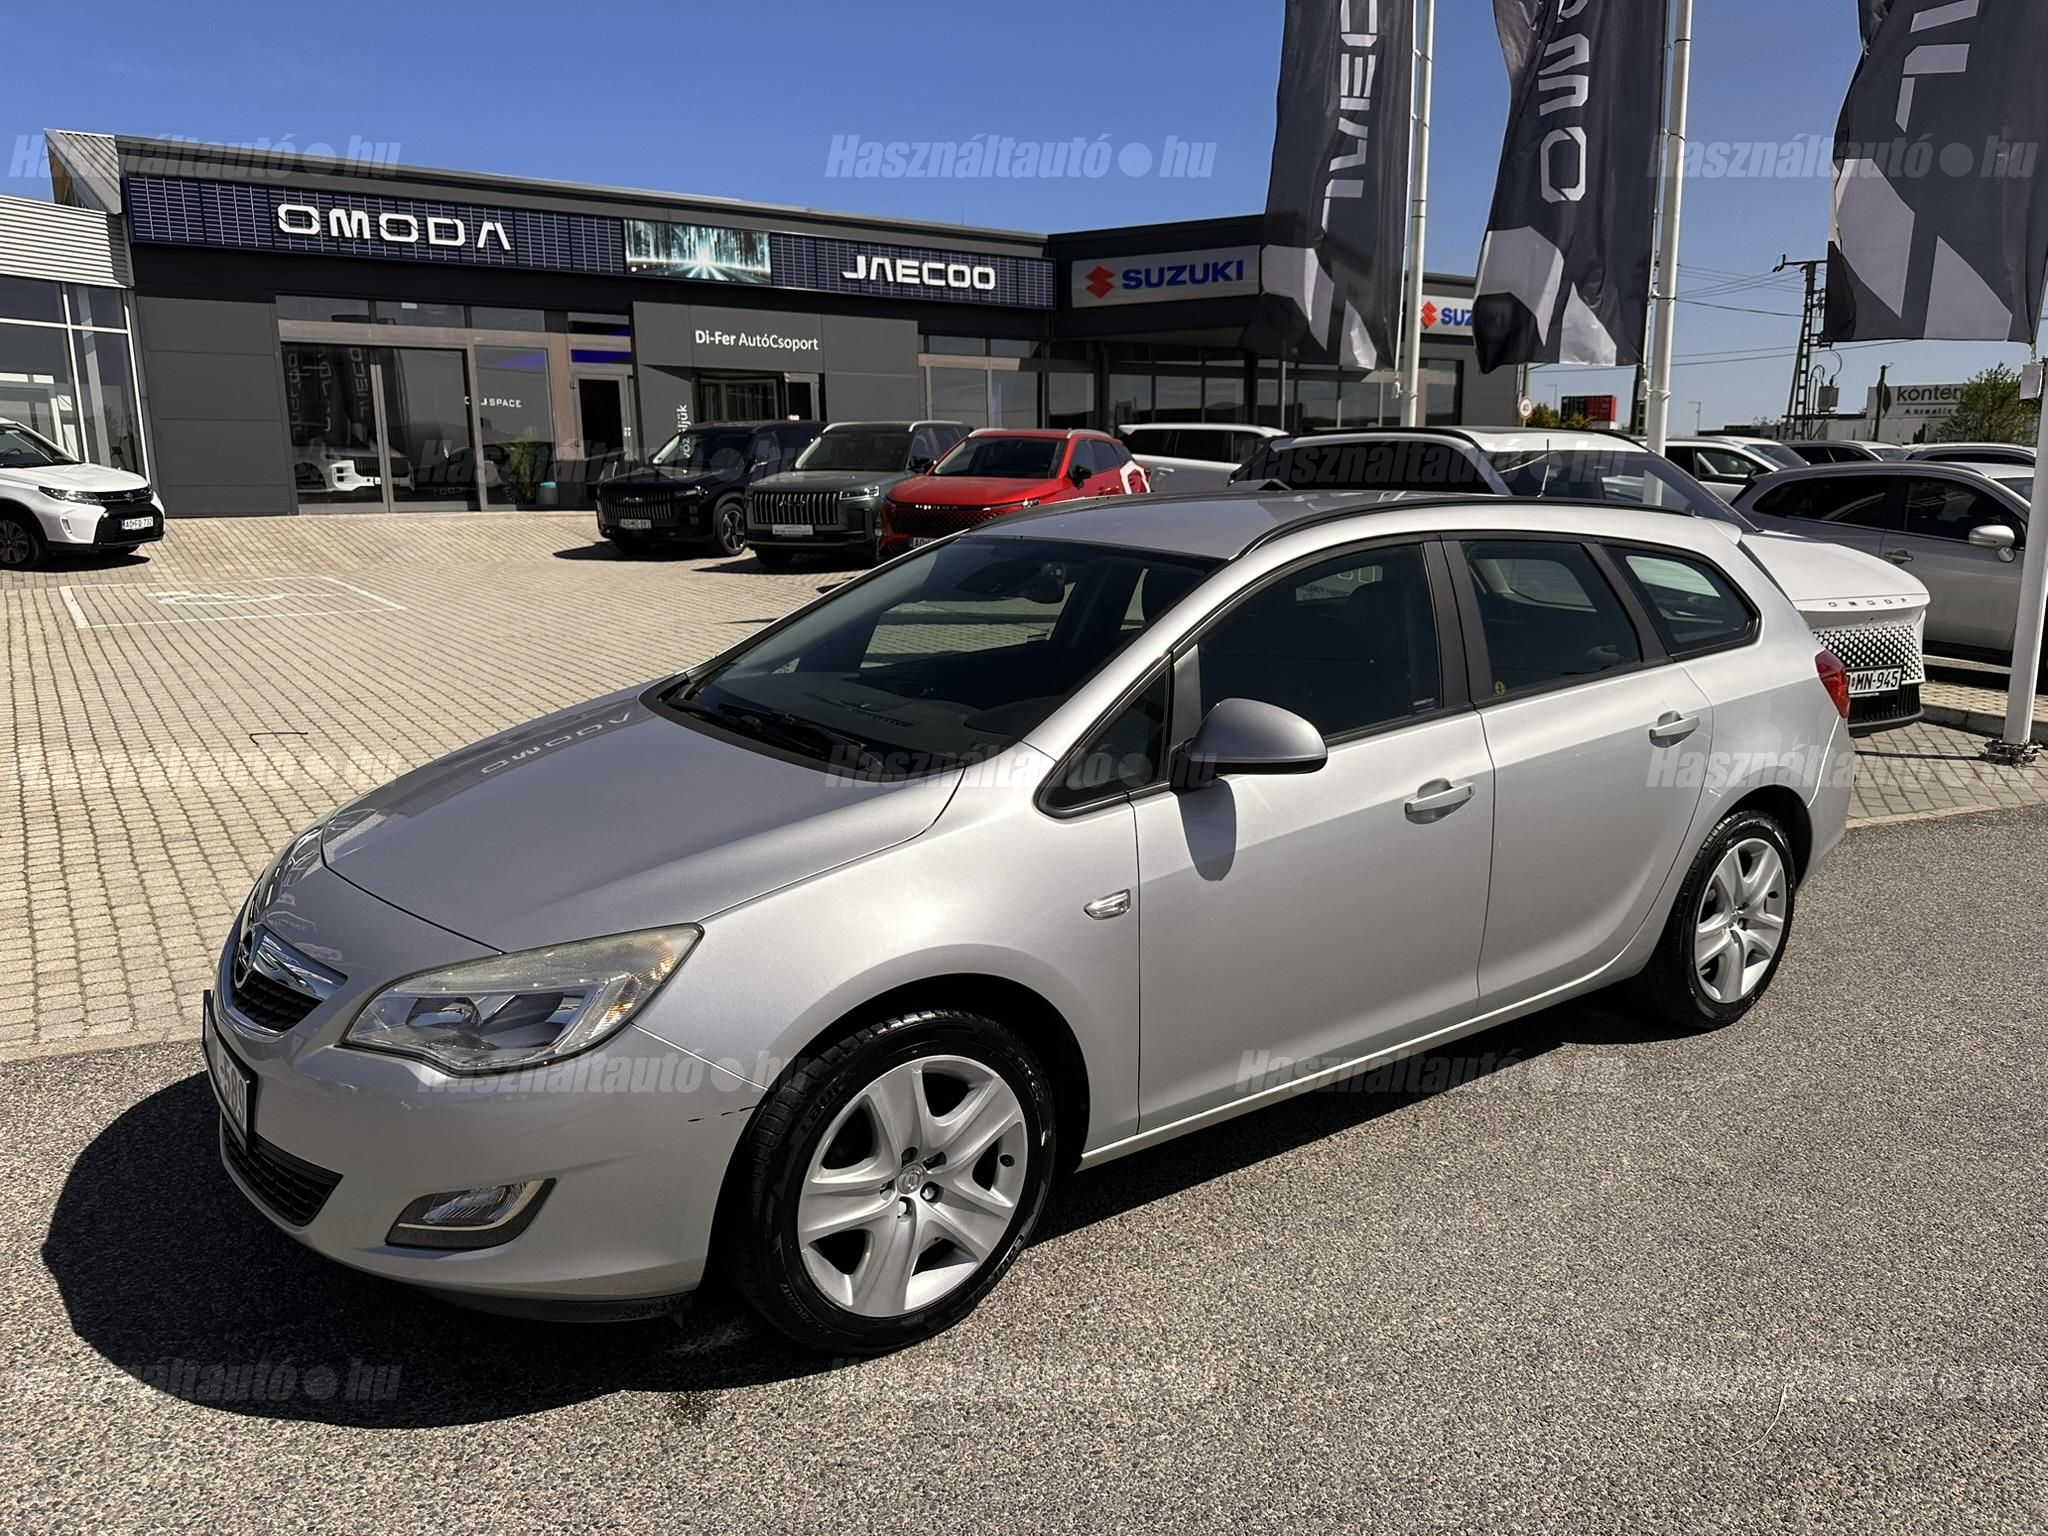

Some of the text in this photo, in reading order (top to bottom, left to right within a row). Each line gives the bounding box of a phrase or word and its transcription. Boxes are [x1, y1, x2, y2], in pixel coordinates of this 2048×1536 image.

[277, 203, 511, 250] OMODA
[842, 255, 996, 290] JAECOO
[1121, 258, 1244, 291] SUZUKI
[1440, 307, 1474, 327] SUZ
[695, 329, 819, 353] Di-Fer AutóCsoport
